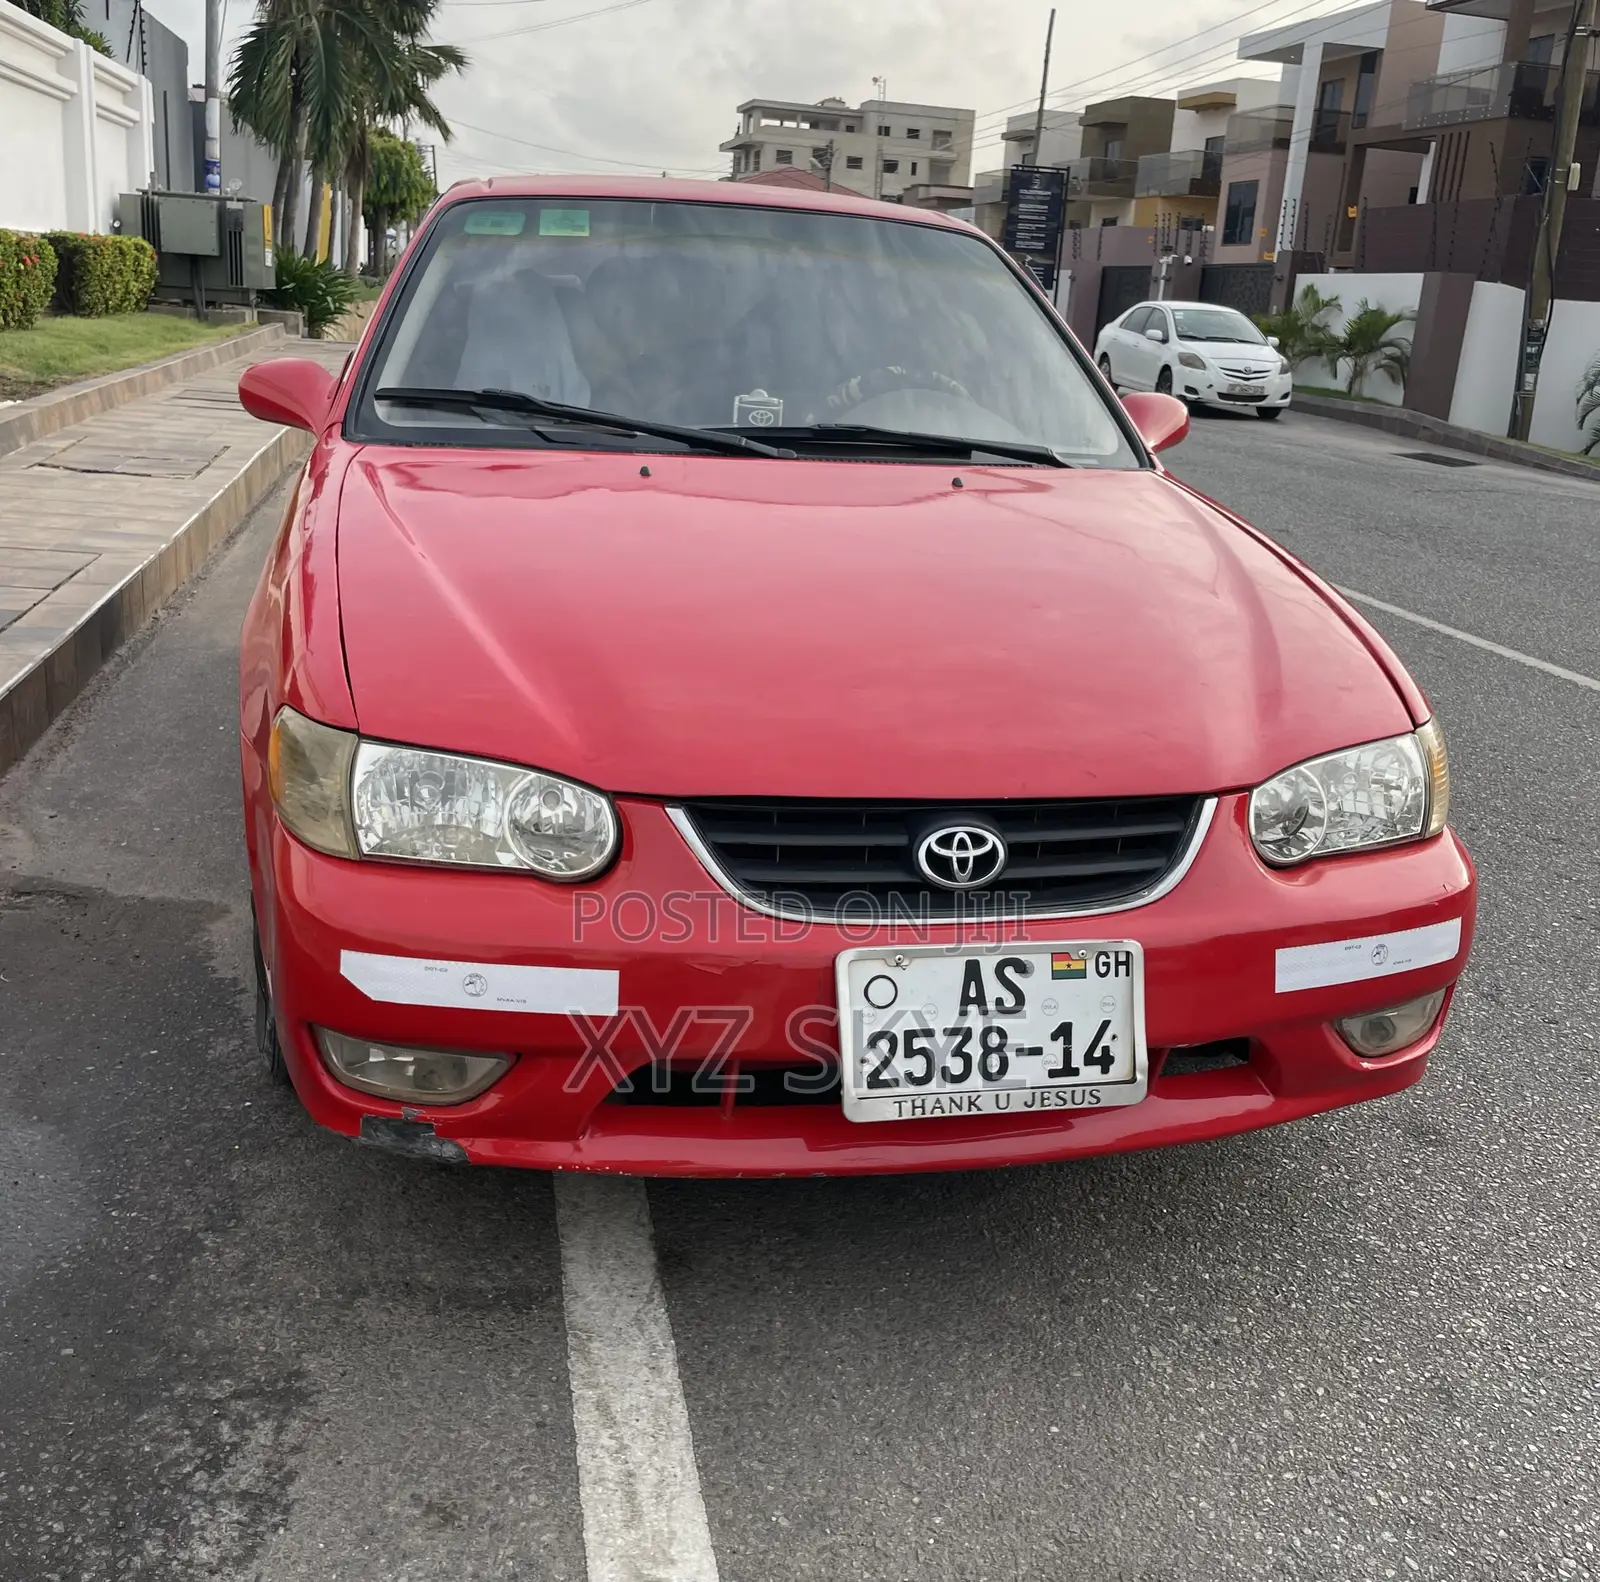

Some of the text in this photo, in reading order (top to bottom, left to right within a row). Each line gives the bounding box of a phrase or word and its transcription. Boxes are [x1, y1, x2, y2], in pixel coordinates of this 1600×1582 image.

[958, 957, 1026, 1016] AS
[1095, 951, 1130, 979] GH
[867, 1019, 1115, 1089] 2538-14
[893, 1088, 1101, 1118] THANK U JESUS
